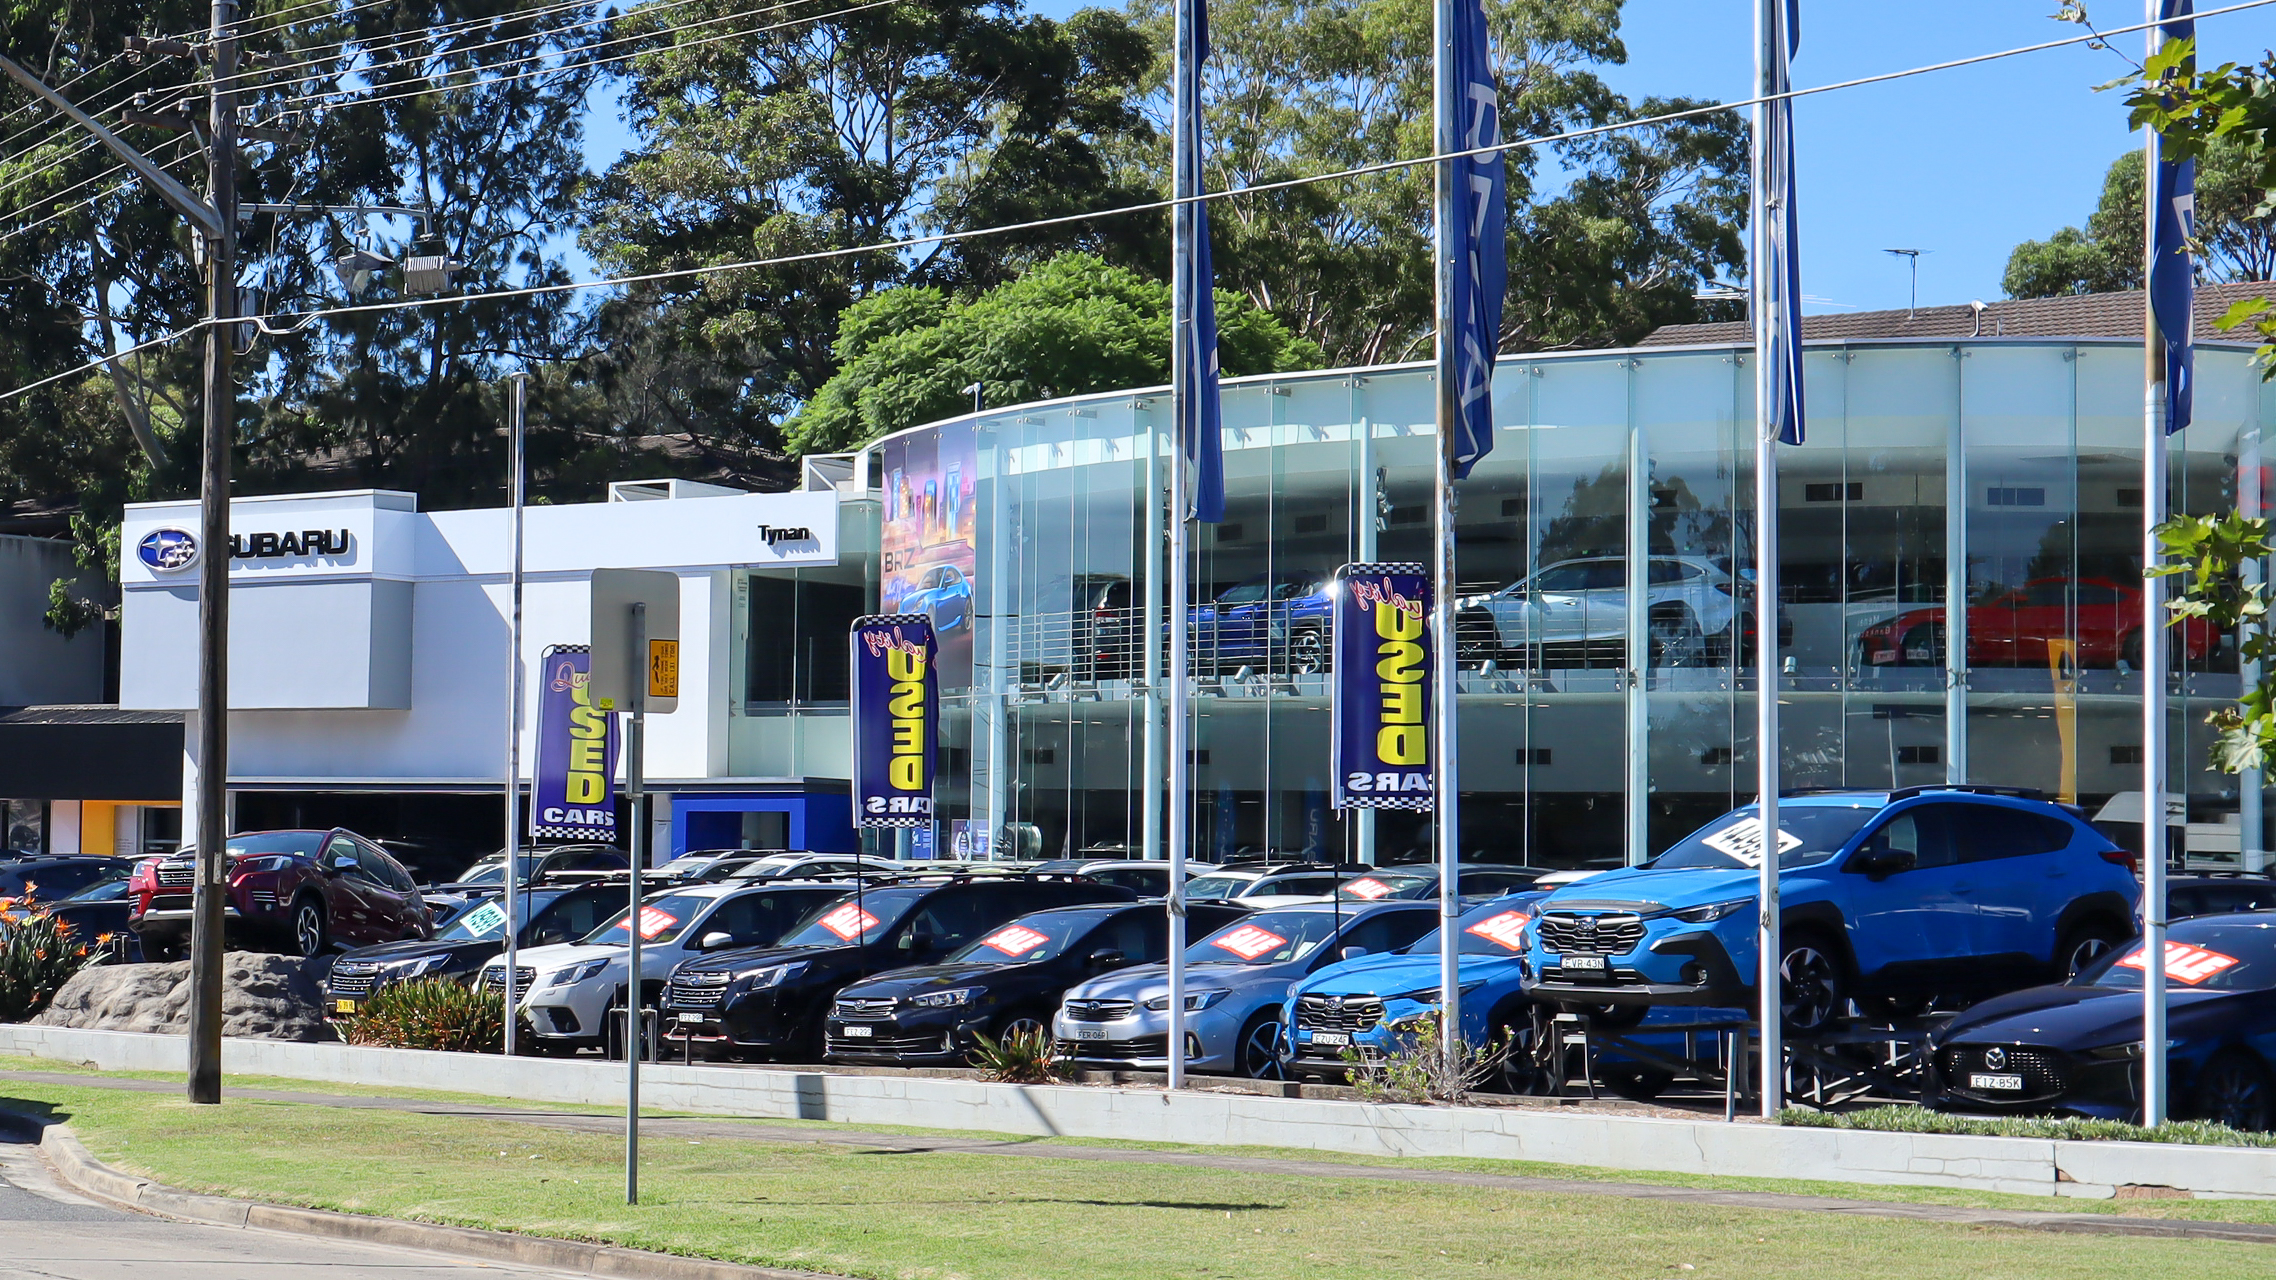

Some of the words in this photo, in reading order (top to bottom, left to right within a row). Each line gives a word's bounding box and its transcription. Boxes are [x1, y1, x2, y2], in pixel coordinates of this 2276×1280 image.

[229, 529, 349, 558] UBARU
[758, 525, 810, 545] Tynan
[884, 548, 915, 573] BRZ
[543, 807, 615, 826] CARS
[1346, 880, 1389, 898] SALE
[823, 907, 875, 937] SALE
[986, 928, 1045, 953] SALE
[1217, 928, 1281, 956] SALE
